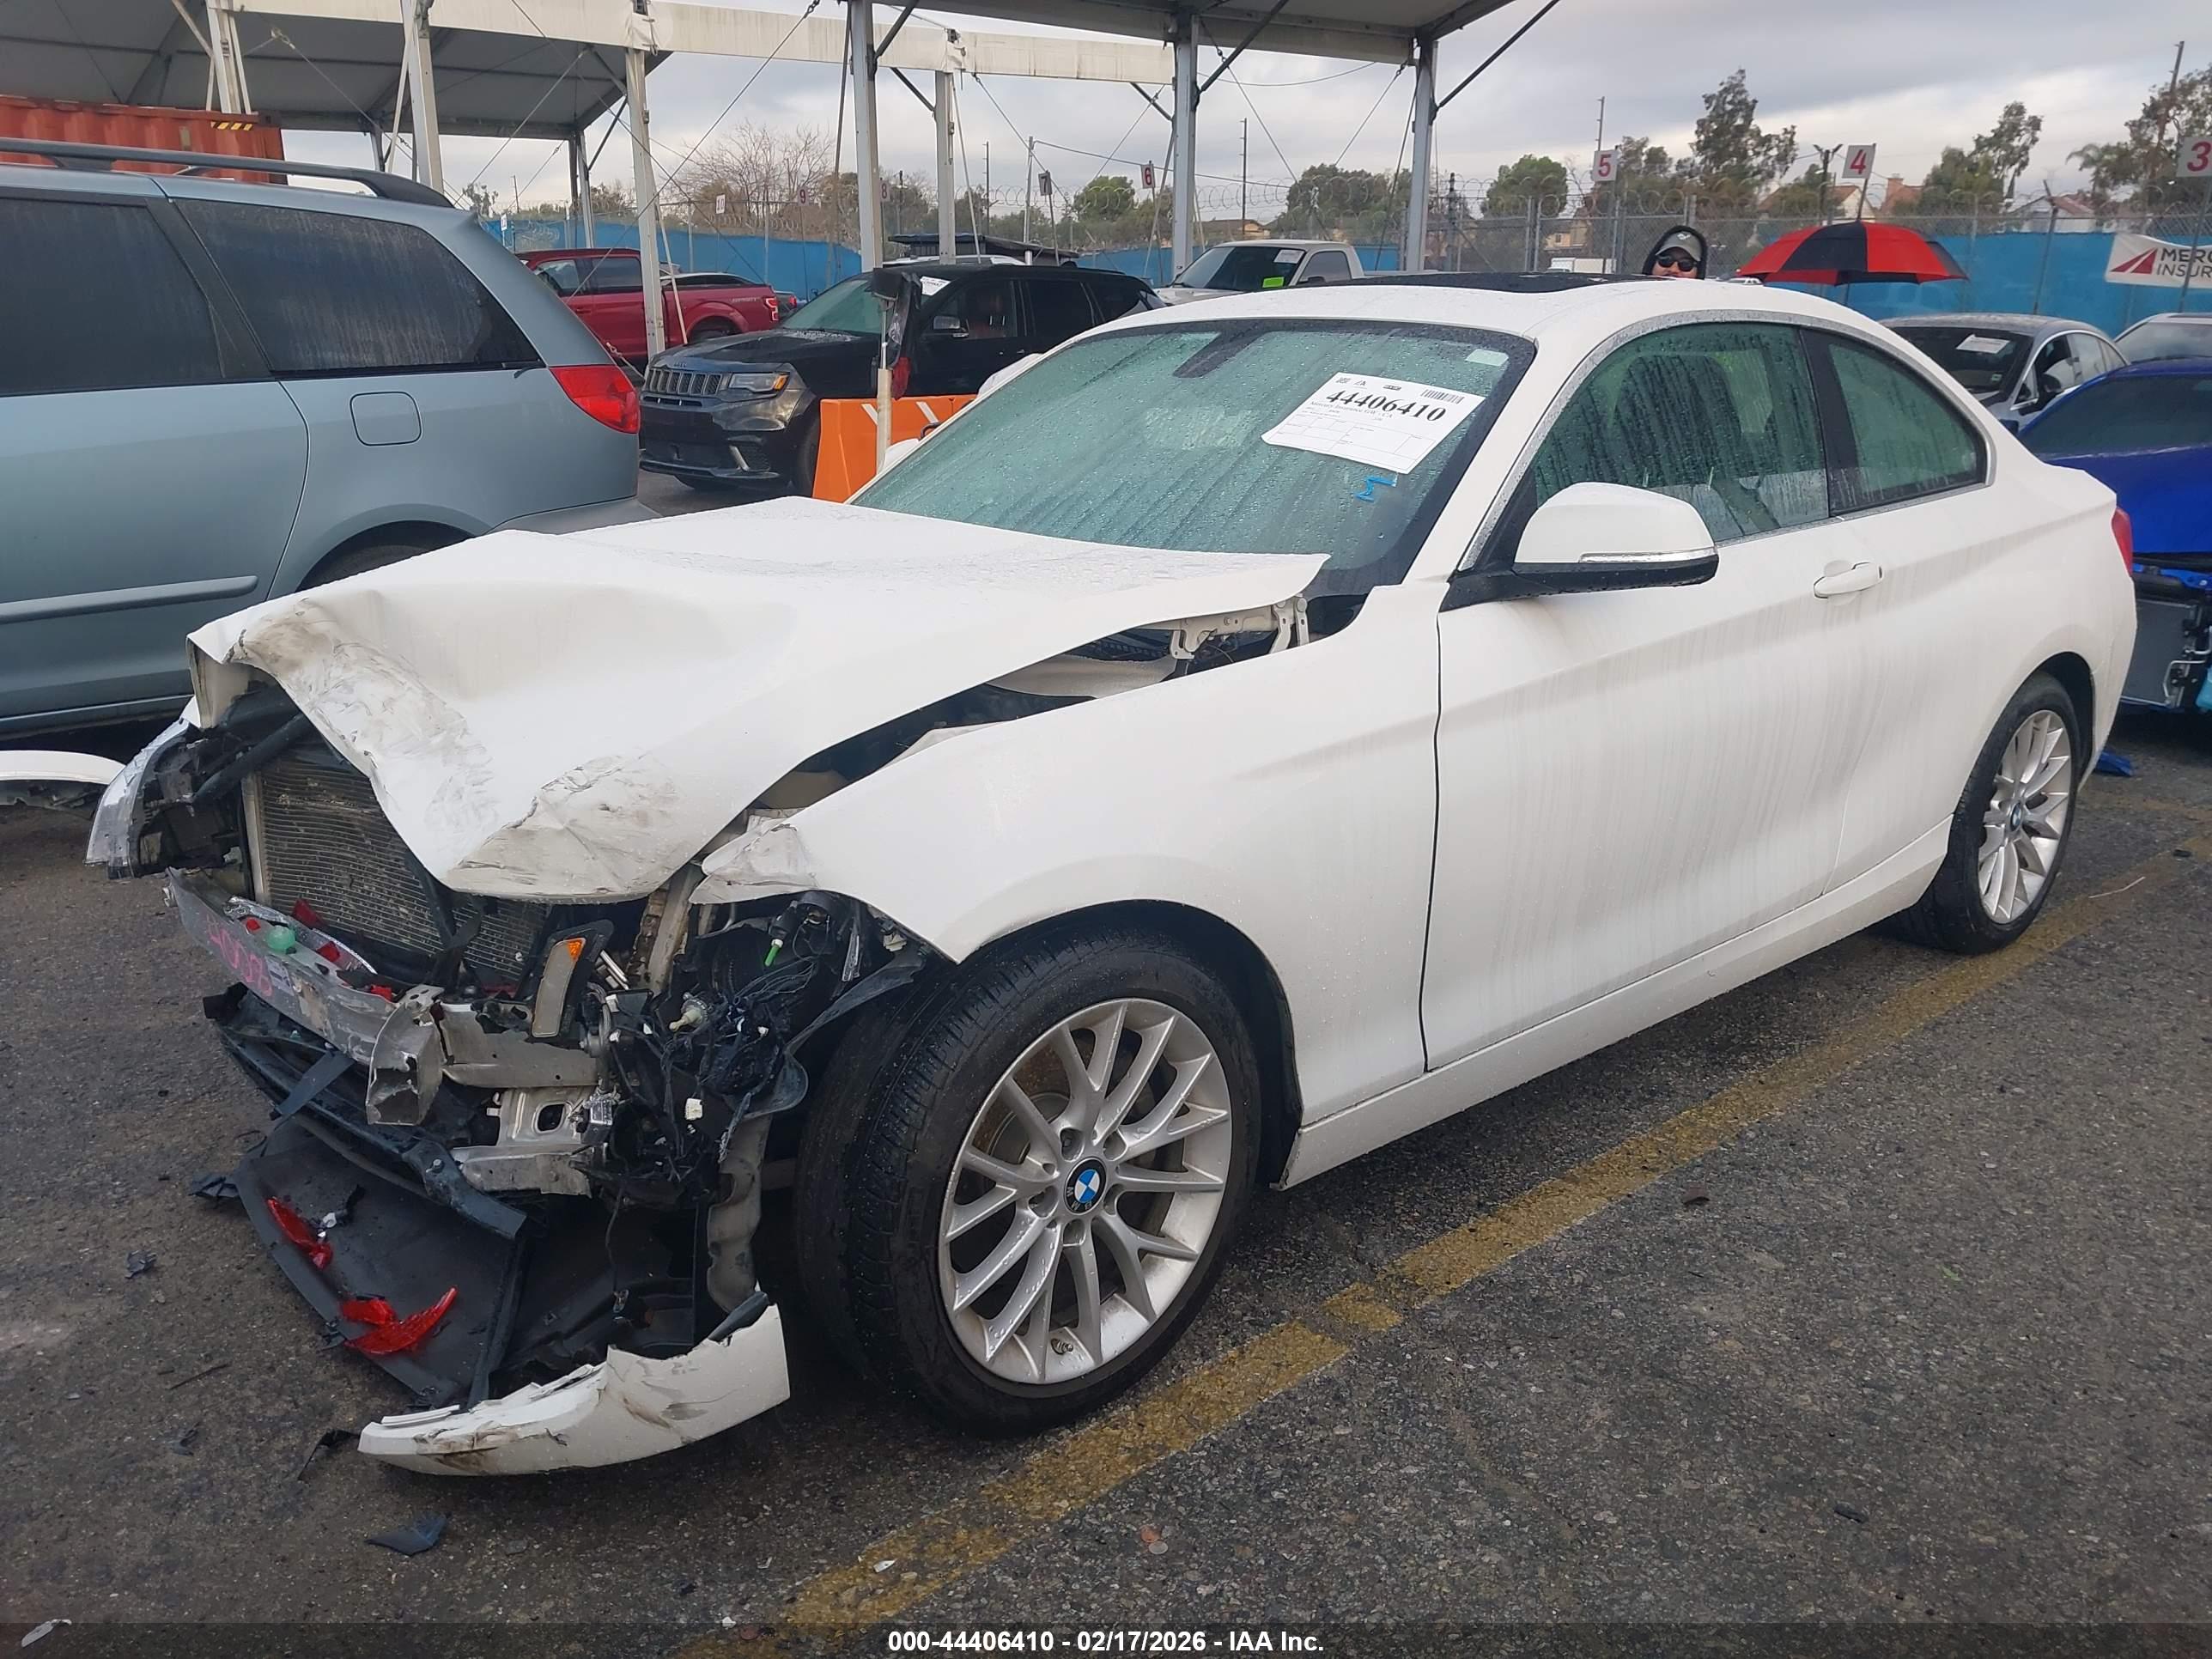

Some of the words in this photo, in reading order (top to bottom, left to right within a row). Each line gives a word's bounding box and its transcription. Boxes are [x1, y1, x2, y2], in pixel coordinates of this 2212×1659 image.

[1598, 153, 1612, 177] 5
[1850, 148, 1867, 175] 4
[2187, 141, 2212, 172] 3
[1041, 174, 1048, 193] 7
[1145, 167, 1152, 185] 6
[799, 188, 806, 204] 9
[881, 184, 888, 199] 8
[716, 198, 725, 211] 10
[1326, 390, 1446, 422] 44406410
